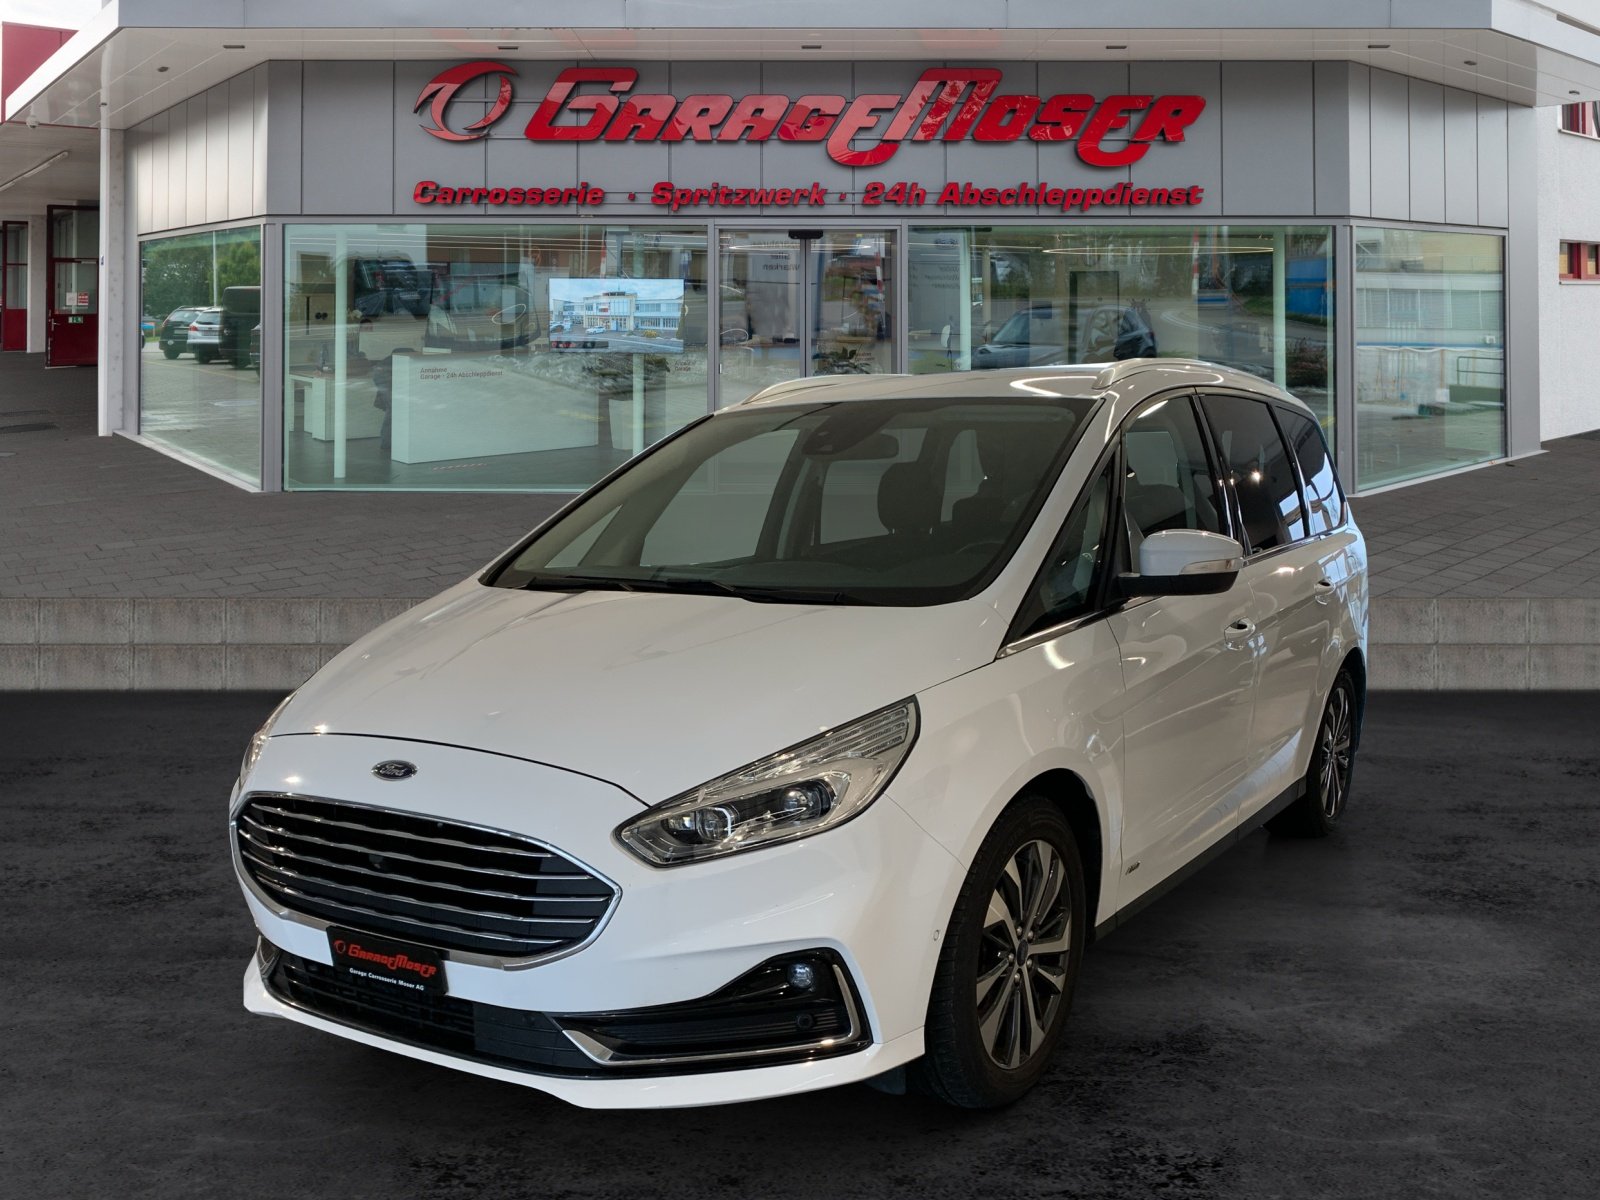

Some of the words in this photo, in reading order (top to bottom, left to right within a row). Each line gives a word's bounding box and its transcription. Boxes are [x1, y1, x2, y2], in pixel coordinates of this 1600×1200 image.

[413, 181, 605, 206] Carrosserie
[651, 182, 827, 211] Spritzwerk
[862, 182, 927, 206] 24h
[937, 182, 1204, 211] Abschleppdienst
[349, 967, 367, 977] Garage
[398, 979, 415, 989] Moser
